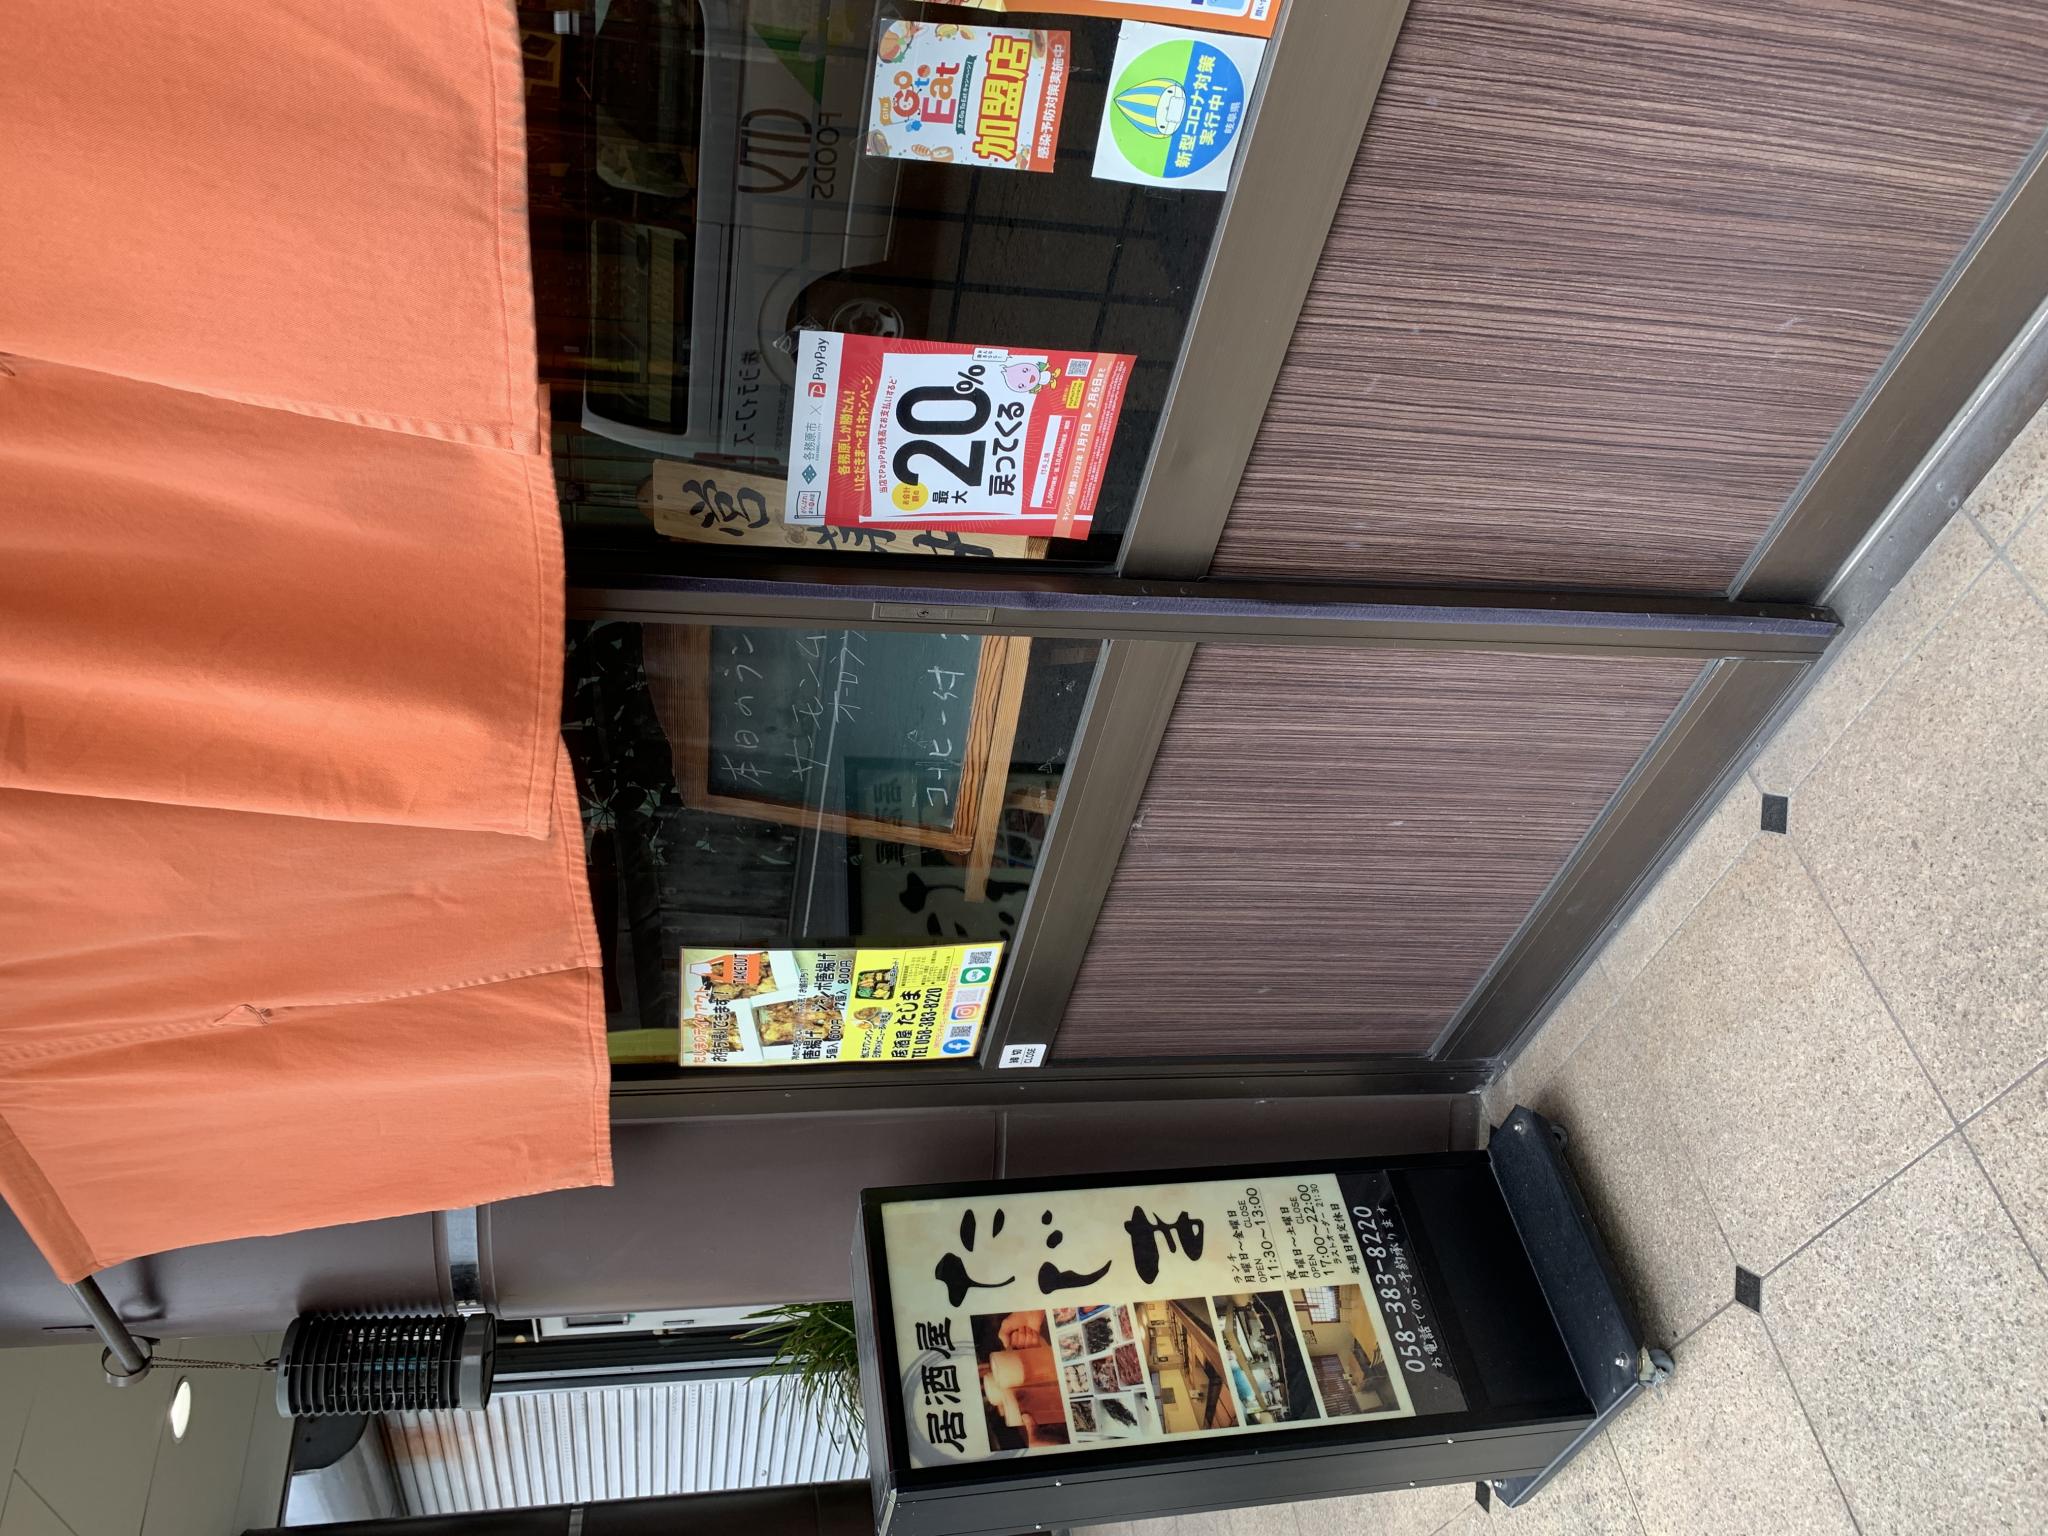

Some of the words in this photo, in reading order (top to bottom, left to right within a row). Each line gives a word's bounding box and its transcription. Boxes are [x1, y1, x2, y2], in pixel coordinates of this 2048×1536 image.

[892, 70, 921, 118] Go
[920, 61, 961, 125] Eat
[973, 36, 1031, 160] 加盟店
[1037, 43, 1065, 159] 感染予防対策実施中
[882, 101, 890, 120] Gifu
[1174, 54, 1217, 168] 新型コロナ対策
[1224, 101, 1242, 134] 岐阜県
[811, 337, 830, 381] PayPay
[802, 422, 818, 461] 各務原市
[988, 401, 1025, 497] 戻ってくる
[1076, 423, 1092, 453] 1月7日
[932, 490, 968, 504] 最大
[732, 953, 748, 984] TAKEOUT
[836, 959, 852, 985] 800円
[833, 988, 849, 1010] 12個入
[893, 989, 921, 1025] たじま
[827, 1019, 842, 1039] 600円
[914, 987, 943, 1045] 058-383-8220
[801, 1030, 823, 1060] 唐揚げ
[890, 1030, 913, 1058] 居酒屋
[911, 1046, 928, 1058] TEL
[1022, 1047, 1037, 1064] CLOSE
[1289, 1196, 1305, 1225] CLOSE
[1309, 1183, 1325, 1208] 21:30
[1237, 1199, 1253, 1229] CLOSE
[1320, 1212, 1342, 1264] ラストオーダー
[1330, 1203, 1361, 1275] 毎週日曜定休日
[934, 1205, 1205, 1308] たじま
[1226, 1252, 1243, 1284] ランチ
[1254, 1258, 1268, 1283] OPEN
[1306, 1253, 1321, 1279] OPEN
[1286, 1269, 1299, 1281] 夜
[1352, 1205, 1426, 1373] 058-383-8220
[1376, 1203, 1443, 1369] お電話でのご予約承ります
[915, 1317, 967, 1453] 居酒屋
